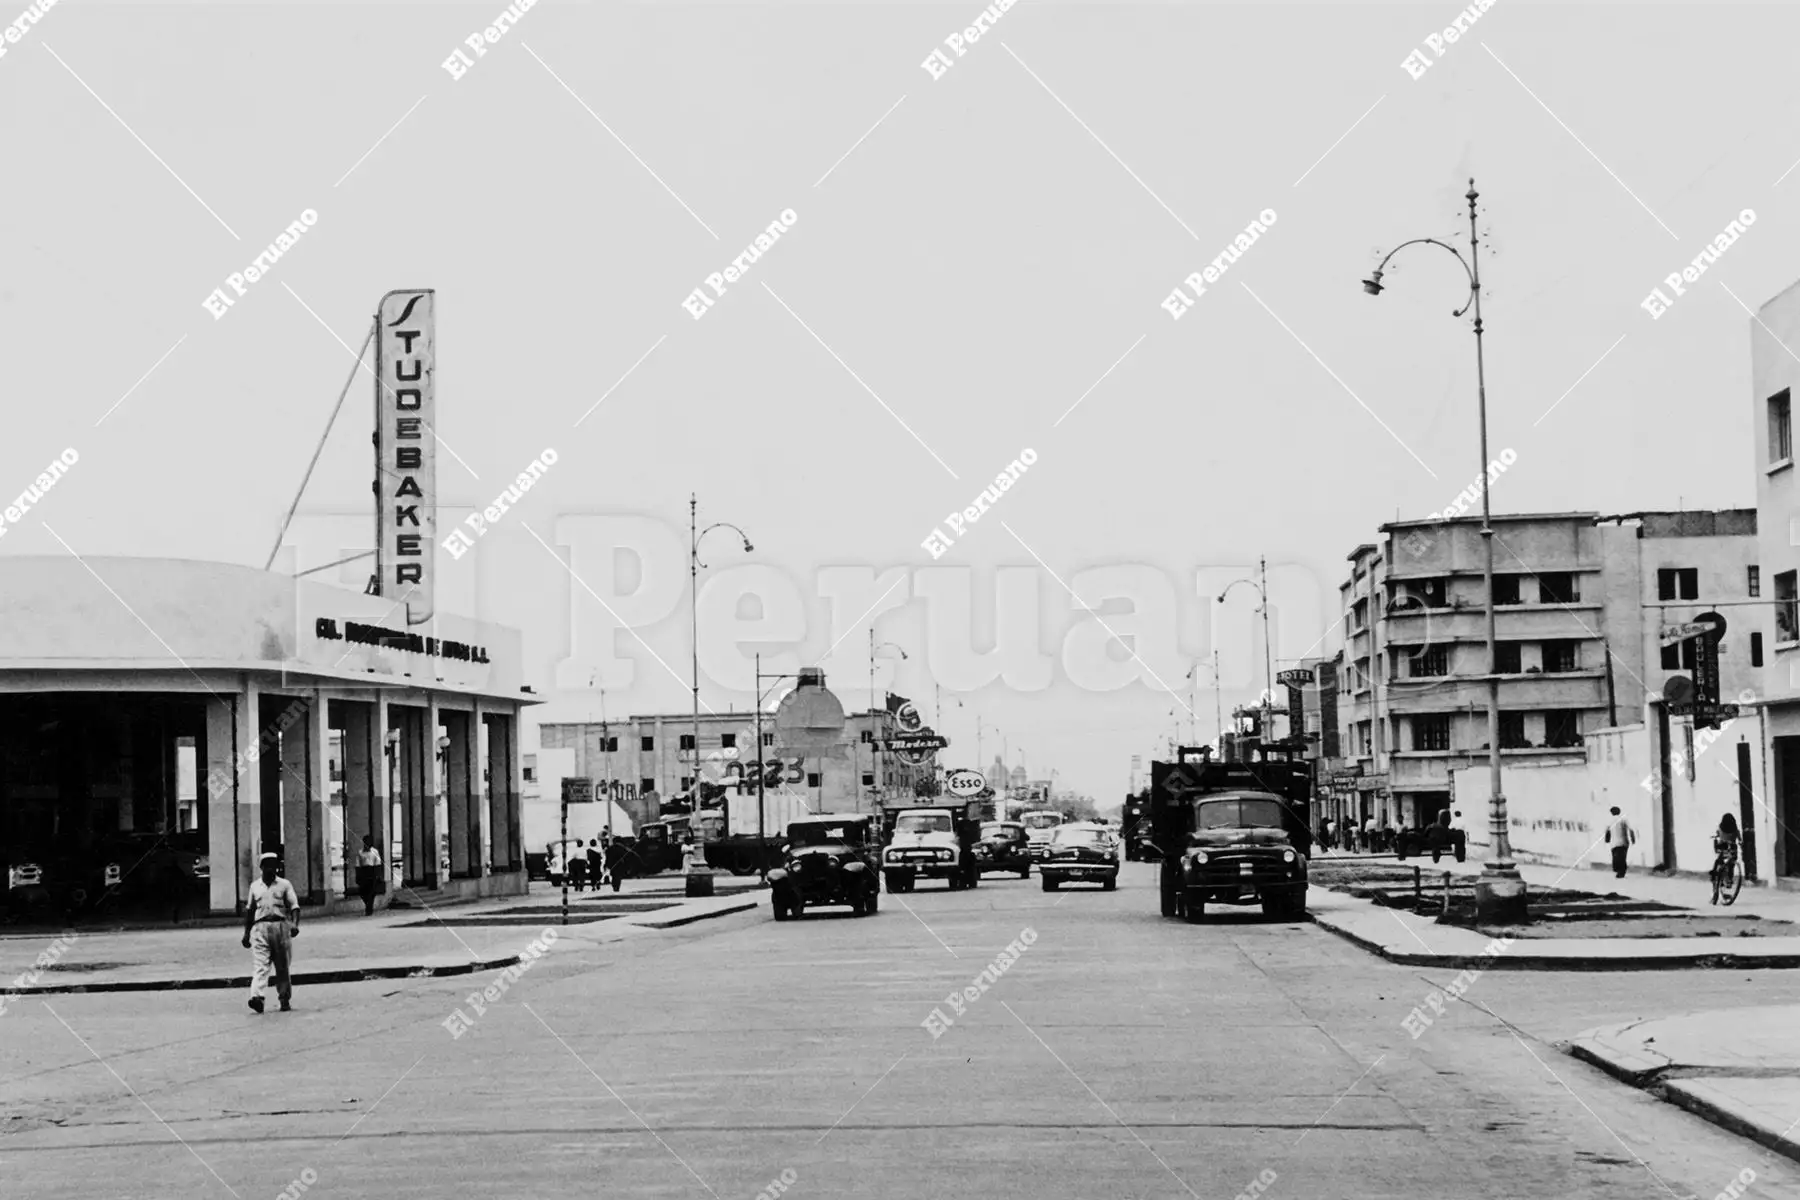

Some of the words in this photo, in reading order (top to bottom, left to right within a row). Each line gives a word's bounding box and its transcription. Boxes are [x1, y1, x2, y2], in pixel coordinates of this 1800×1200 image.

[388, 295, 422, 585] STUDEBAKER
[1279, 671, 1310, 681] HOTEL
[952, 777, 981, 788] Esso
